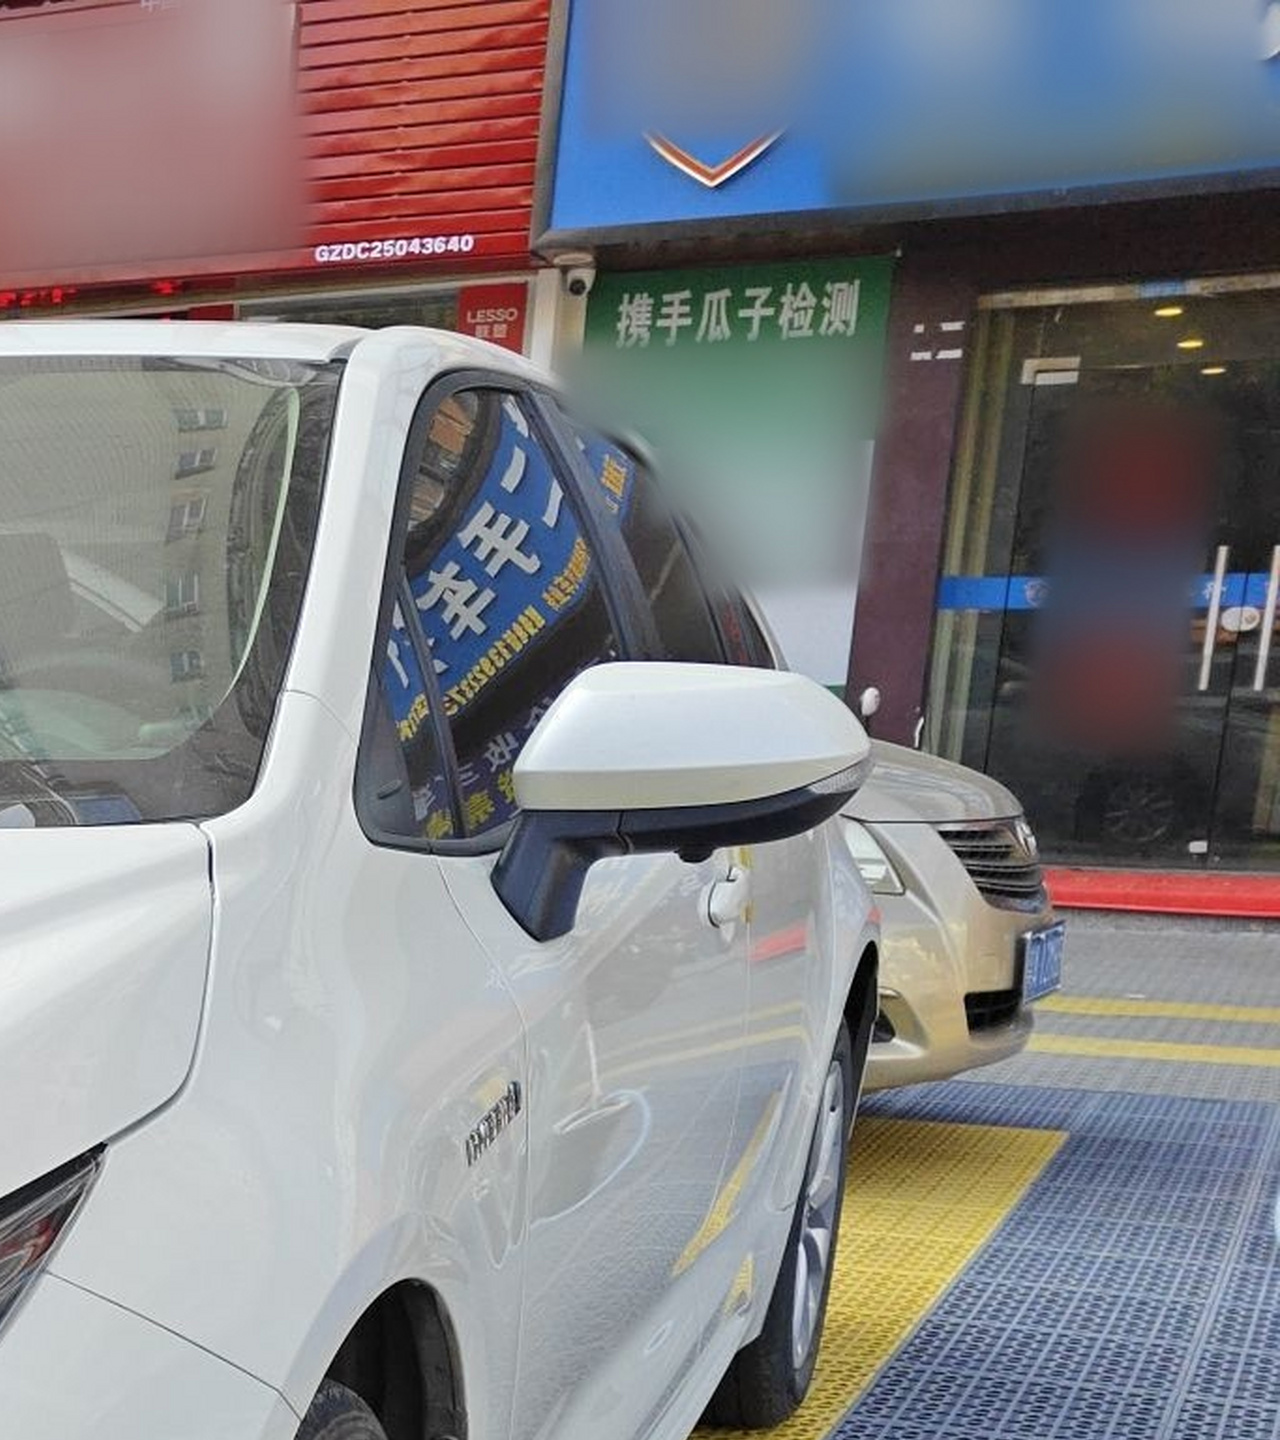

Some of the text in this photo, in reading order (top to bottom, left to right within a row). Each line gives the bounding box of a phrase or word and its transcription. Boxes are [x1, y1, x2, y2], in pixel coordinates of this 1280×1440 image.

[314, 234, 475, 262] GZDC25043640
[466, 307, 519, 323] LESSO
[615, 279, 861, 348] 携手瓜子检测
